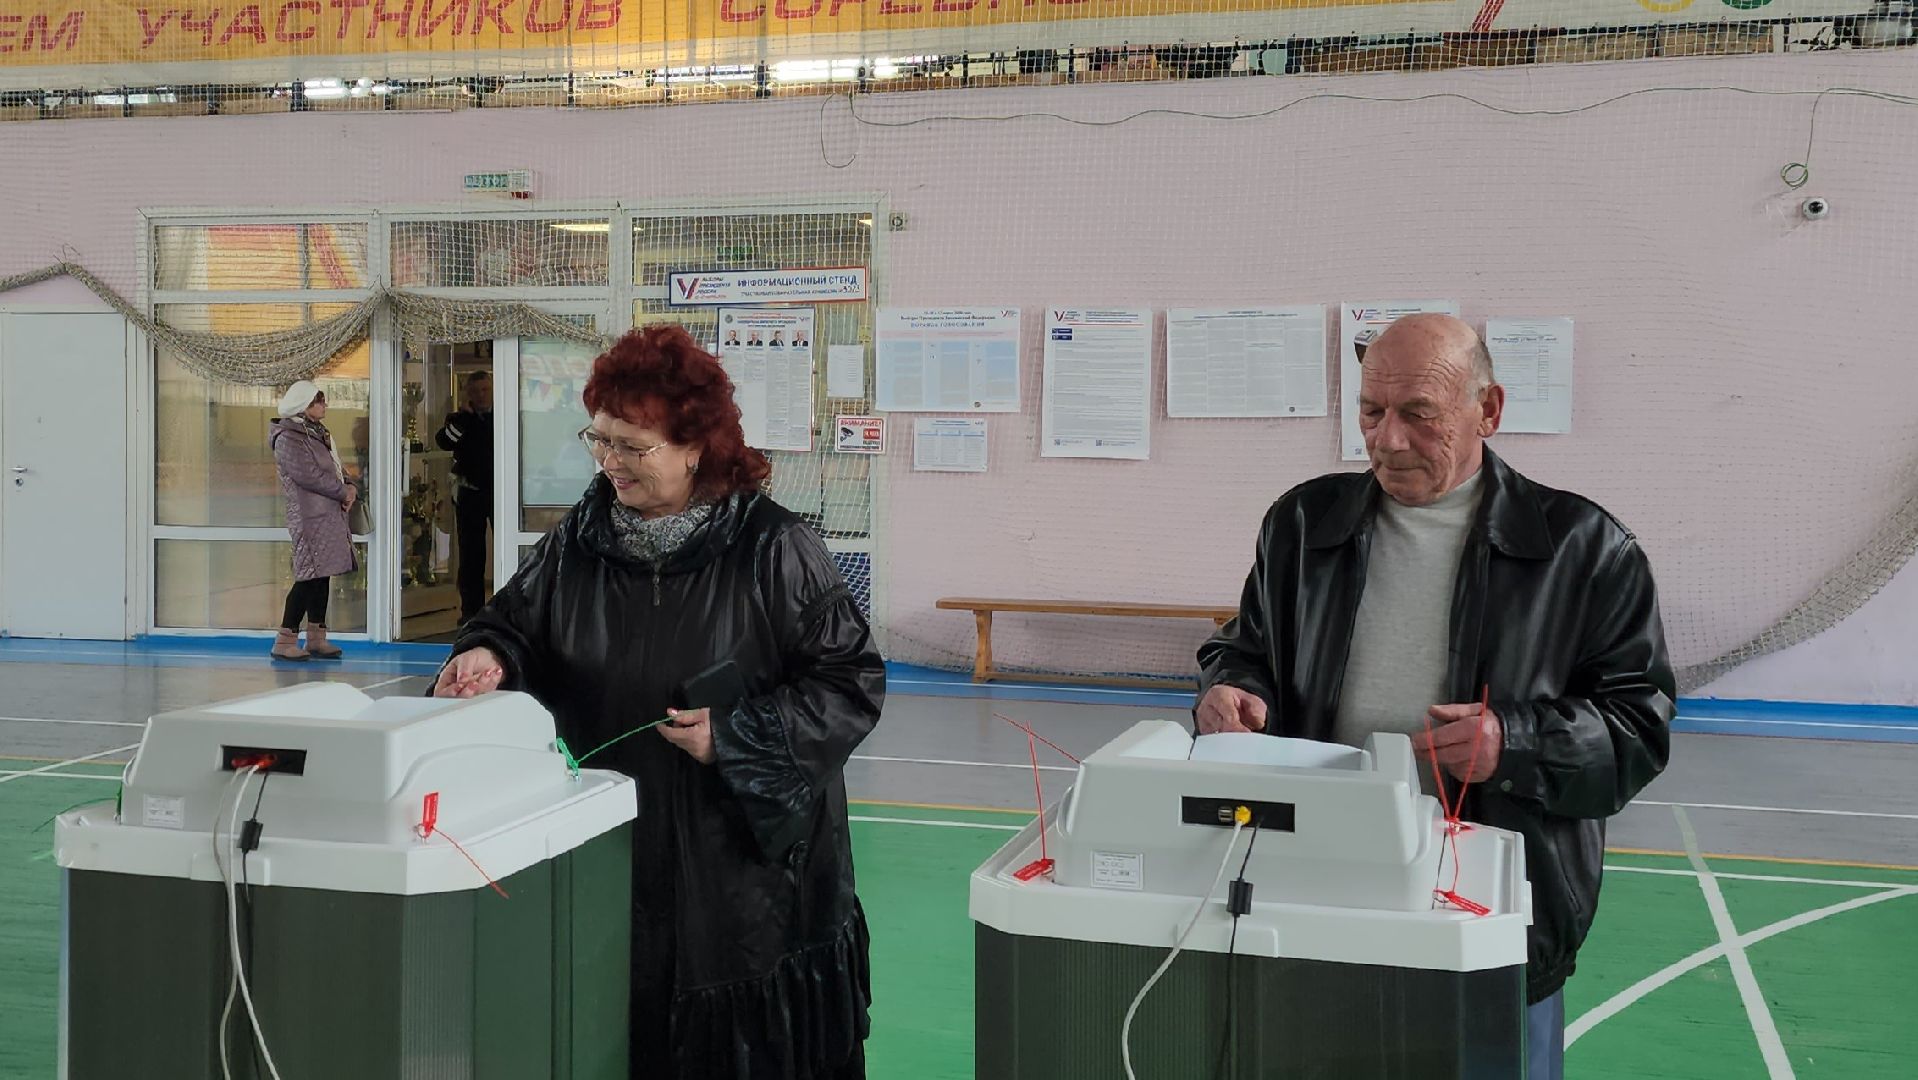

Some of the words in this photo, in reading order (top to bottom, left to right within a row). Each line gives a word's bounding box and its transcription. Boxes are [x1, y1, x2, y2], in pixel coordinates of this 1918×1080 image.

[136, 0, 622, 50] УЧАСТНИКОВ
[737, 275, 827, 287] ИНФОРМАЦИОННЫЙ
[828, 274, 858, 285] СТЕНД
